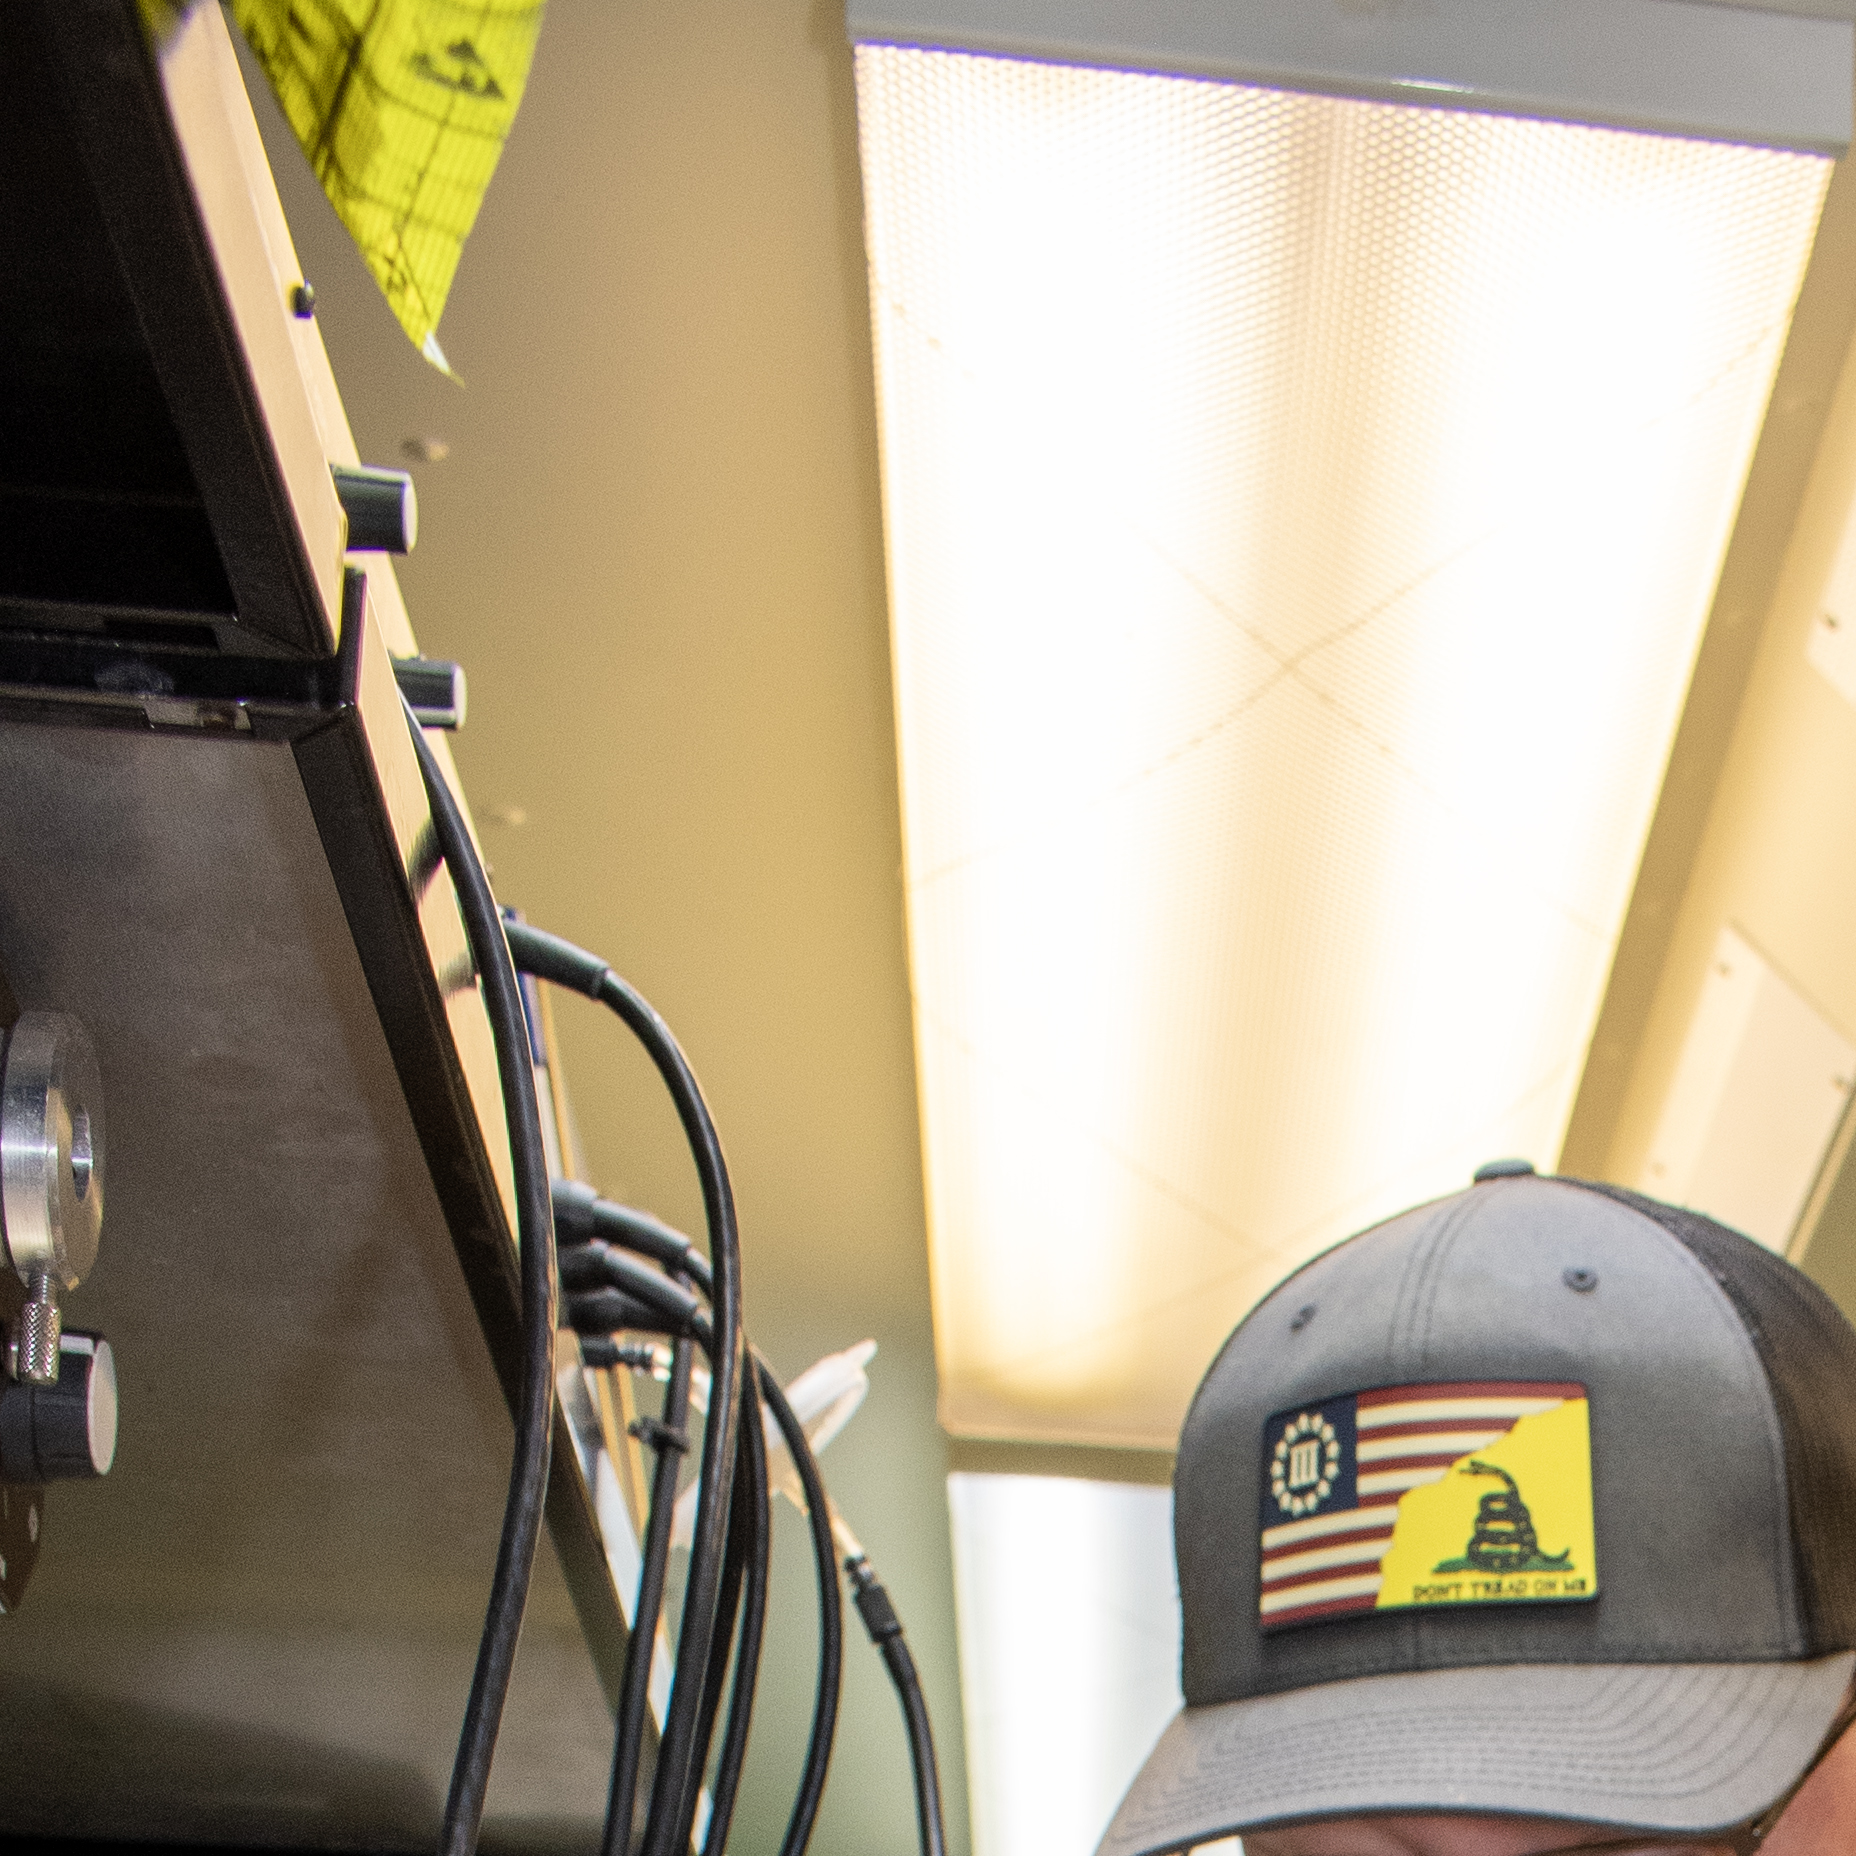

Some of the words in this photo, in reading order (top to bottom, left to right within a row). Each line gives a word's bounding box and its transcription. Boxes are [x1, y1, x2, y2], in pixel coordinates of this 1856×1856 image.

[1413, 1581, 1463, 1602] DON'T
[1470, 1579, 1528, 1599] TREAD
[1533, 1578, 1557, 1597] ON
